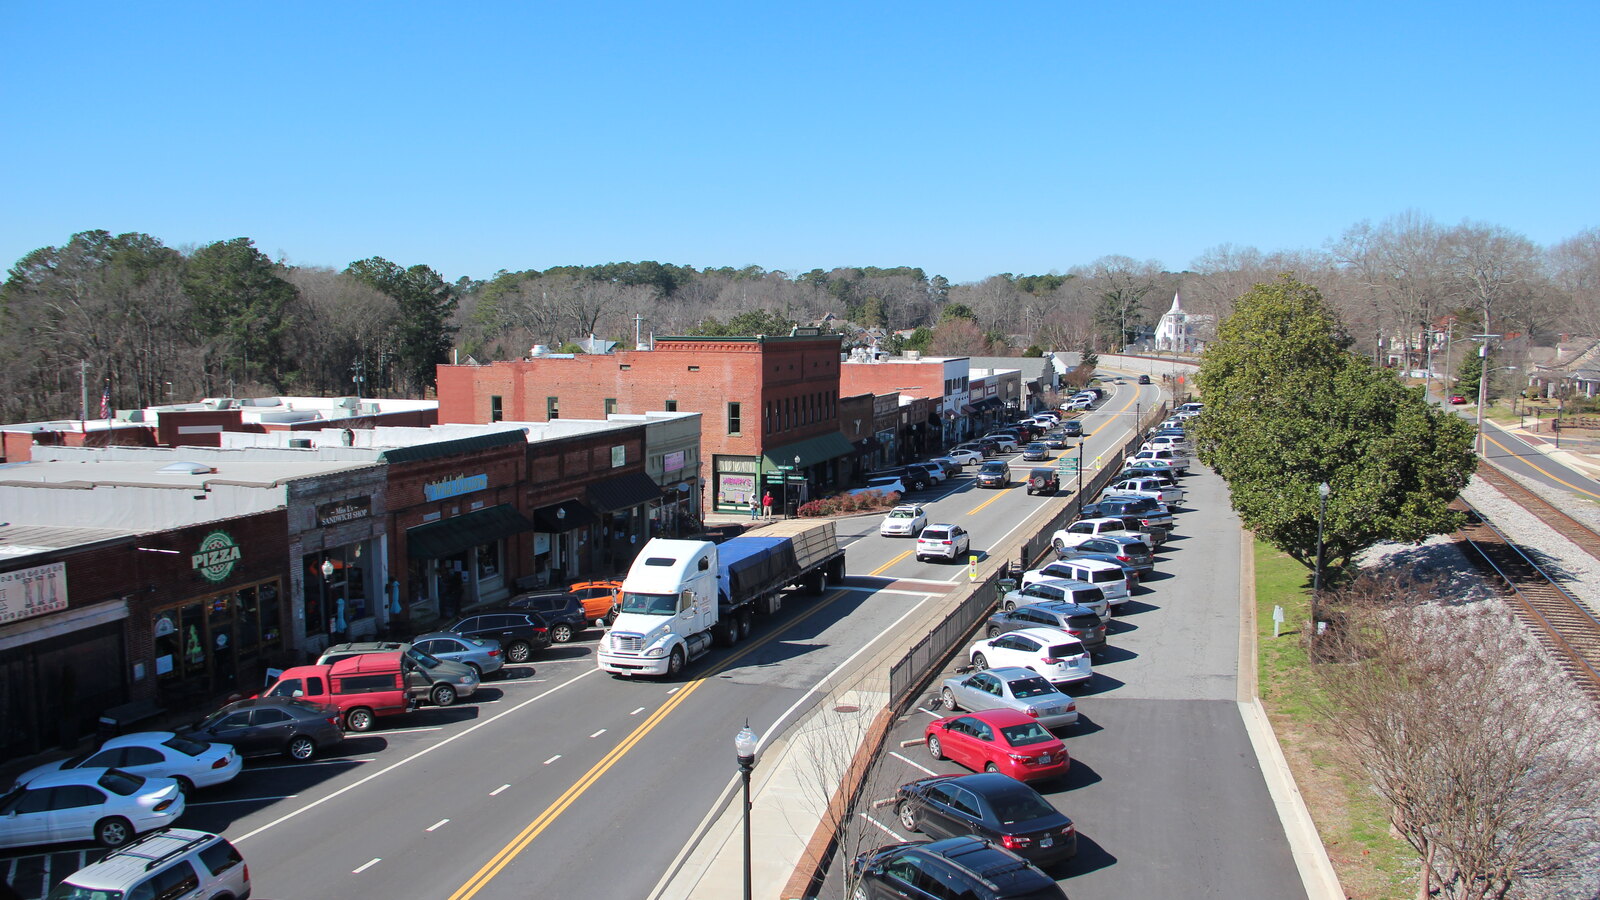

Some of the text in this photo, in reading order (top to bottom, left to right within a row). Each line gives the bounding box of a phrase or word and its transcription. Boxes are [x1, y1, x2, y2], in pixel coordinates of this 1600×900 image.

[322, 509, 368, 526] SANDWICH SHOP
[336, 506, 347, 514] Miss
[191, 546, 241, 570] PIZZA
